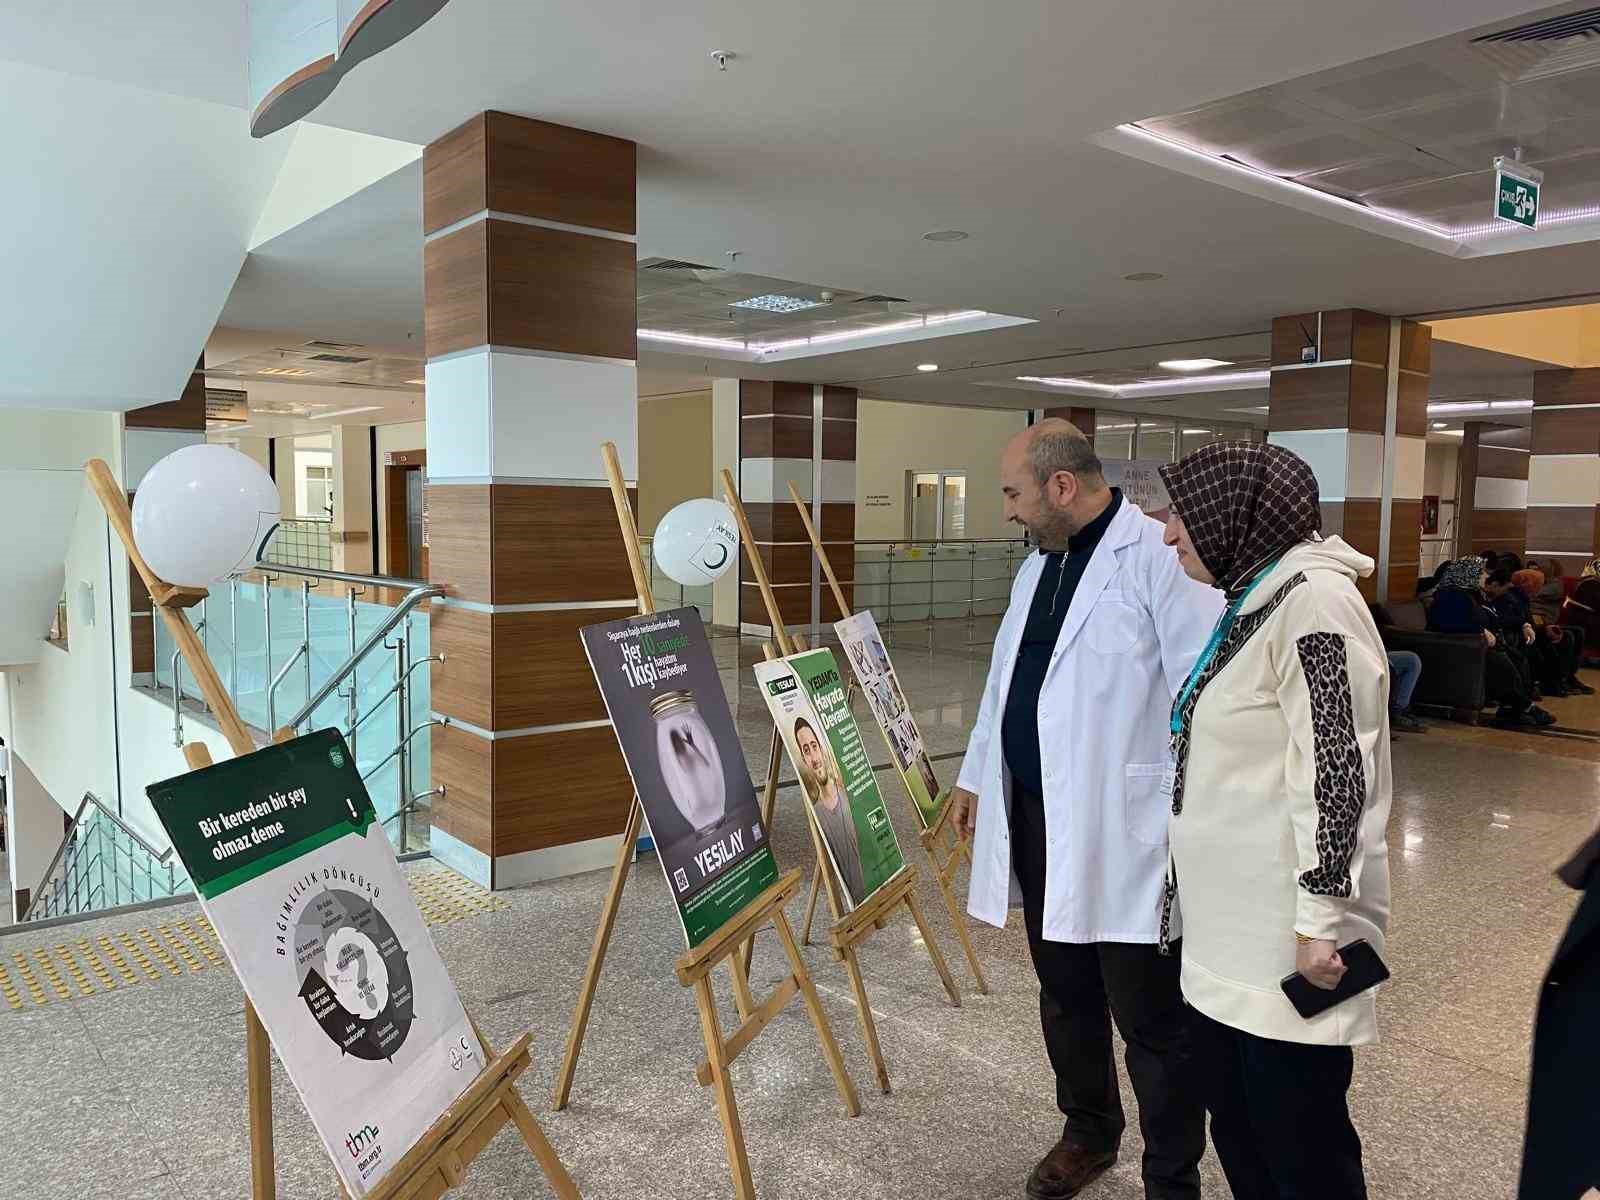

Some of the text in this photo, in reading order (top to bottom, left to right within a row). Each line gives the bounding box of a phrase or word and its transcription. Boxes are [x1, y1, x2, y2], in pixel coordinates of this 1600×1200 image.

[620, 642, 641, 662] Her
[629, 656, 658, 689] kişi
[813, 688, 844, 711] Hayata
[198, 787, 306, 839] Bir kereden bir şey
[212, 821, 285, 861] olmaz deme
